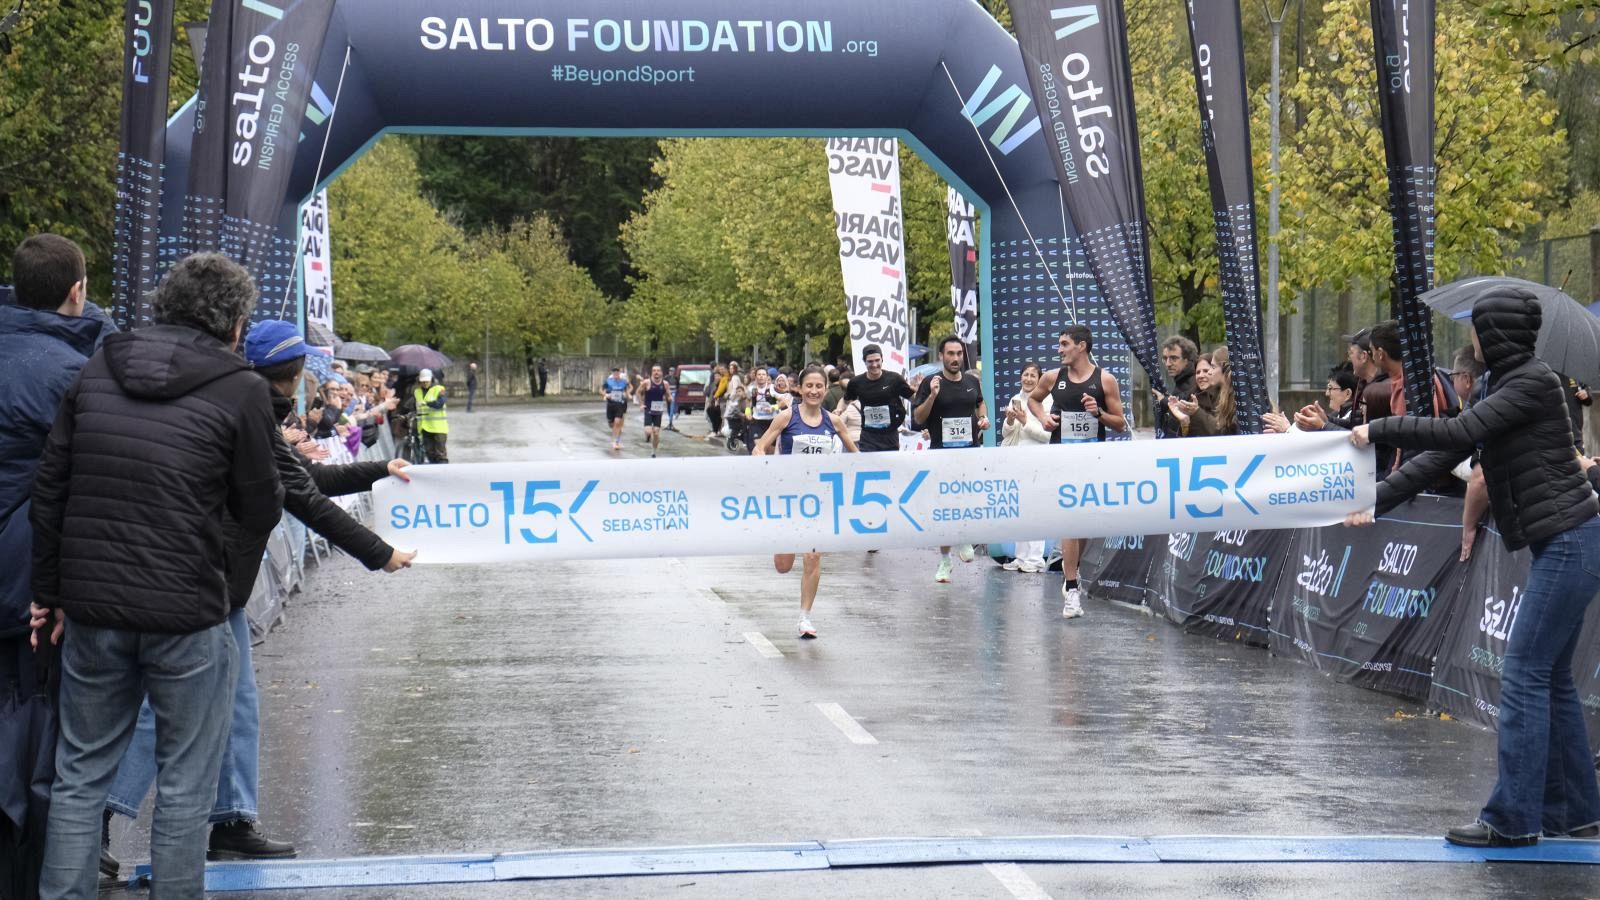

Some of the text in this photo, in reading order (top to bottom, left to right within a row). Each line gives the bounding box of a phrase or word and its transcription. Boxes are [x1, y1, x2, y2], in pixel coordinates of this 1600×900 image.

[420, 16, 878, 57] SALTO FOUNDATION .org
[551, 64, 695, 86] #BeyondSport
[232, 34, 276, 167] salto
[257, 42, 300, 171] INSPIRED ACCESS
[949, 427, 965, 436] 314
[1069, 423, 1090, 432] 156
[801, 446, 823, 455] 416
[1274, 462, 1354, 479] DONOSTIA
[938, 479, 1019, 495] DONOSTIA
[1322, 475, 1355, 490] SAN
[608, 490, 689, 505] DONOSTIA
[987, 493, 1019, 507] SAN
[1057, 479, 1159, 509] SALTO
[1268, 488, 1355, 505] SEBASTIAN
[656, 503, 689, 518] SAN
[720, 493, 821, 521] SALTO
[932, 505, 1020, 521] SEBASTIAN
[390, 502, 490, 530] SALTO
[602, 517, 689, 532] SEBASTIAN
[1377, 541, 1418, 577] SALTO
